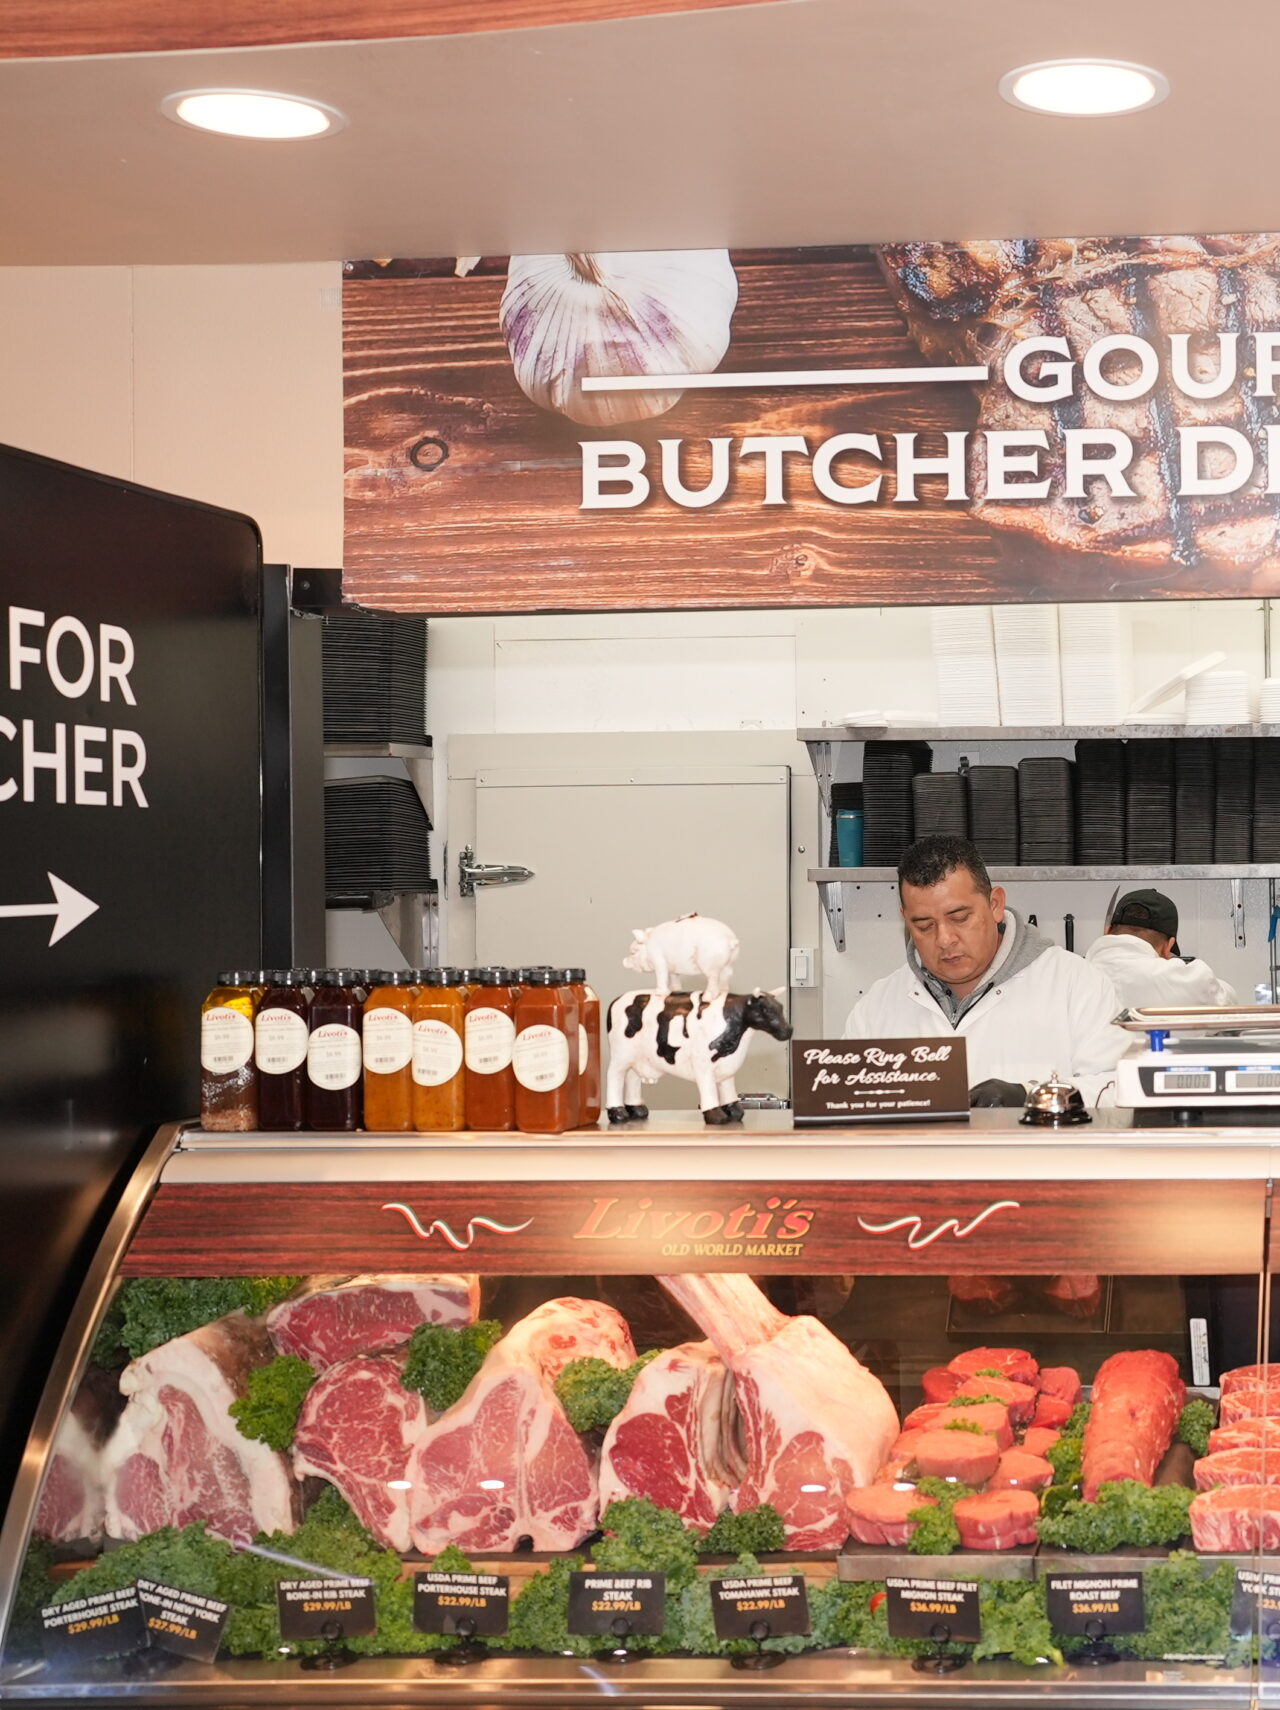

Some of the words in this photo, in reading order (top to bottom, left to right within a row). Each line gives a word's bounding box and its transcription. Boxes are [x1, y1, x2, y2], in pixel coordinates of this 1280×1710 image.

[577, 428, 1138, 510] BUTCHER
[9, 605, 137, 706] FOR
[803, 1048, 861, 1065] Please
[863, 1047, 908, 1070] Ring
[911, 1045, 952, 1062] Bell
[811, 1069, 840, 1091] for
[844, 1068, 941, 1086] Assistance.
[825, 1101, 848, 1109] Thank
[850, 1102, 864, 1110] you
[866, 1101, 877, 1109] for
[879, 1101, 895, 1110] your
[897, 1099, 931, 1109] patience!
[573, 1197, 815, 1239] Livoti's
[662, 1243, 690, 1256] OLD
[694, 1243, 743, 1256] WORLD
[745, 1243, 803, 1256] MARKET
[280, 1581, 299, 1590] DRY
[299, 1580, 323, 1589] AGED
[323, 1579, 349, 1588] PRIME
[427, 1573, 451, 1582] USDA
[451, 1574, 477, 1584] PRIME
[478, 1576, 498, 1585] BEEF
[585, 1579, 613, 1589] PRIME
[614, 1579, 635, 1589] BEEF
[636, 1579, 652, 1589] RIB
[721, 1579, 746, 1589] USDA
[746, 1578, 773, 1587] PRIME
[773, 1576, 793, 1586] BEEF
[886, 1578, 910, 1588] USDA
[910, 1579, 936, 1590] PRIME
[936, 1581, 956, 1591] BEEF
[956, 1582, 978, 1592] FILET
[1051, 1580, 1073, 1590] FILET
[1073, 1579, 1111, 1589] MIGNON
[1112, 1578, 1138, 1589] PRIME
[137, 1579, 157, 1591] DRY
[155, 1585, 181, 1599] AGED
[180, 1592, 207, 1607] PRIME
[206, 1599, 228, 1613] BEEF
[286, 1591, 322, 1601] BONE-IN
[323, 1590, 338, 1599] RIB
[339, 1589, 366, 1598] STEAK
[417, 1583, 478, 1595] PORTERHOUSE
[480, 1586, 507, 1597] STEAK
[603, 1591, 633, 1601] STEAK
[718, 1589, 771, 1600] TOMAHAWK
[772, 1586, 800, 1597] STEAK
[900, 1589, 937, 1600] MIGNON
[938, 1591, 965, 1602] STEAK
[1069, 1591, 1099, 1601] ROAST
[1100, 1590, 1120, 1600] BEEF
[41, 1605, 61, 1617] DRY
[62, 1599, 87, 1613] AGED
[87, 1592, 115, 1606] PRIME
[115, 1587, 137, 1600] BEEF
[303, 1601, 352, 1612] $29.99/LB
[437, 1596, 487, 1607] $22.99/LB
[591, 1600, 642, 1612] $22.99/LB
[736, 1599, 786, 1612] $22.99/LB
[43, 1604, 109, 1628] PORTERHOUSE
[109, 1598, 139, 1612] STEAK
[160, 1610, 189, 1625] STEAK
[172, 1602, 195, 1615] NEW
[195, 1607, 220, 1623] YORK
[67, 1614, 119, 1634] $29.99/LB
[148, 1617, 198, 1640] $27.99/LB
